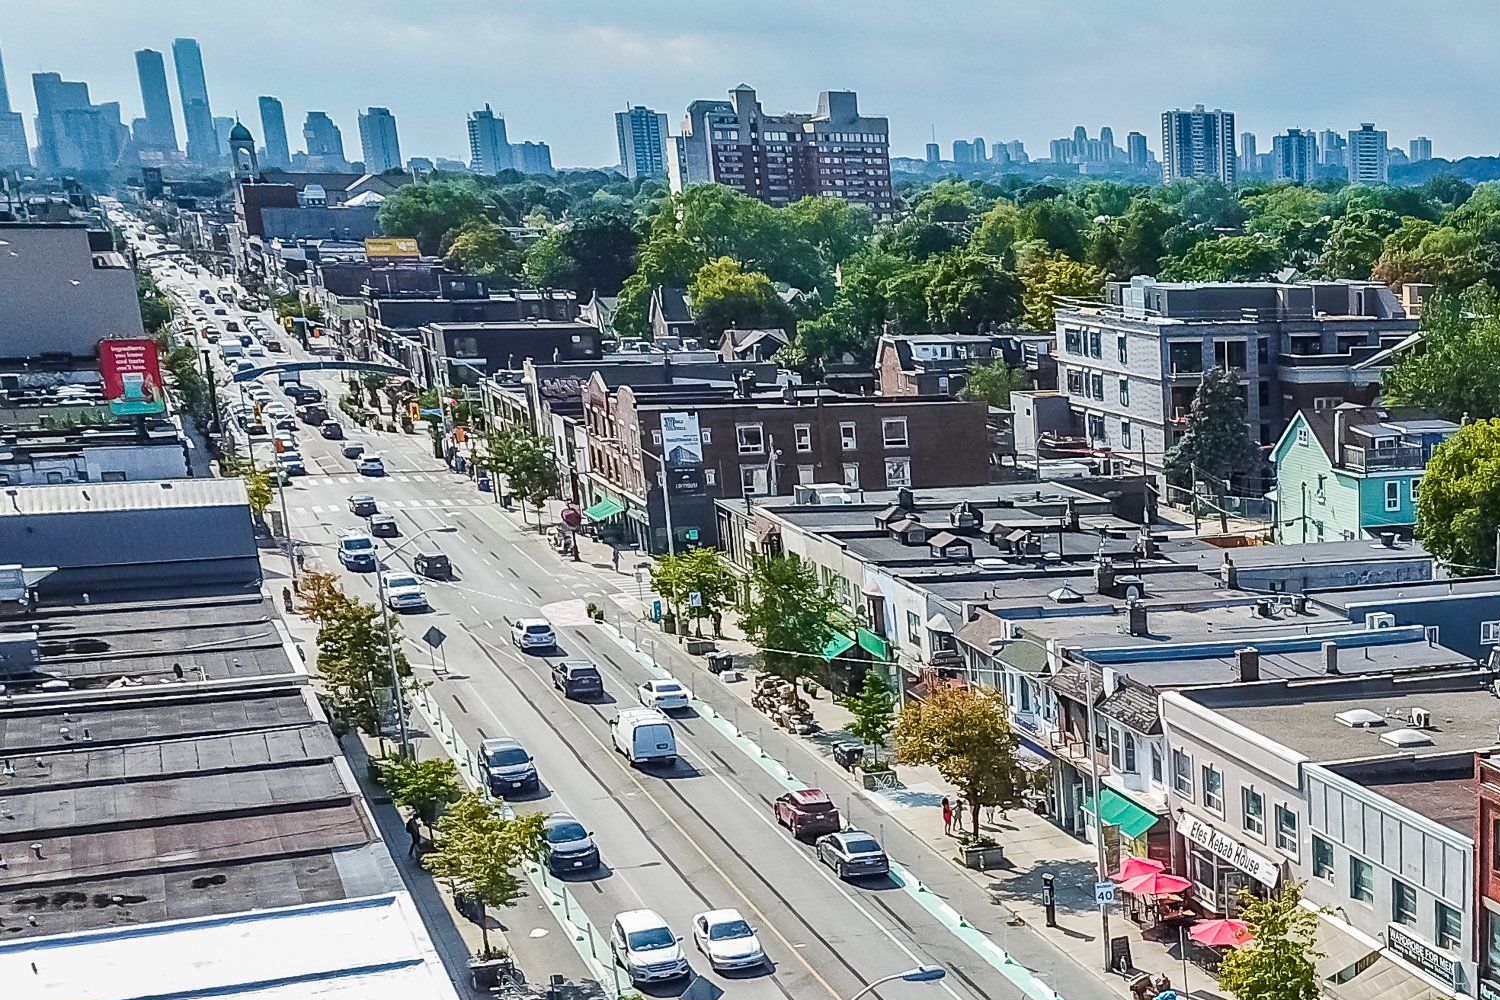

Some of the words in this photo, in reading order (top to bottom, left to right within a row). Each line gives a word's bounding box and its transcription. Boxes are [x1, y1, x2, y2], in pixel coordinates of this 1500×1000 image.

[1190, 821, 1207, 844] Efes
[1207, 828, 1233, 859] Kebab
[1233, 846, 1260, 875] House
[1097, 890, 1113, 901] 40
[1389, 927, 1425, 959] WARDROBE
[1424, 948, 1439, 967] FOR
